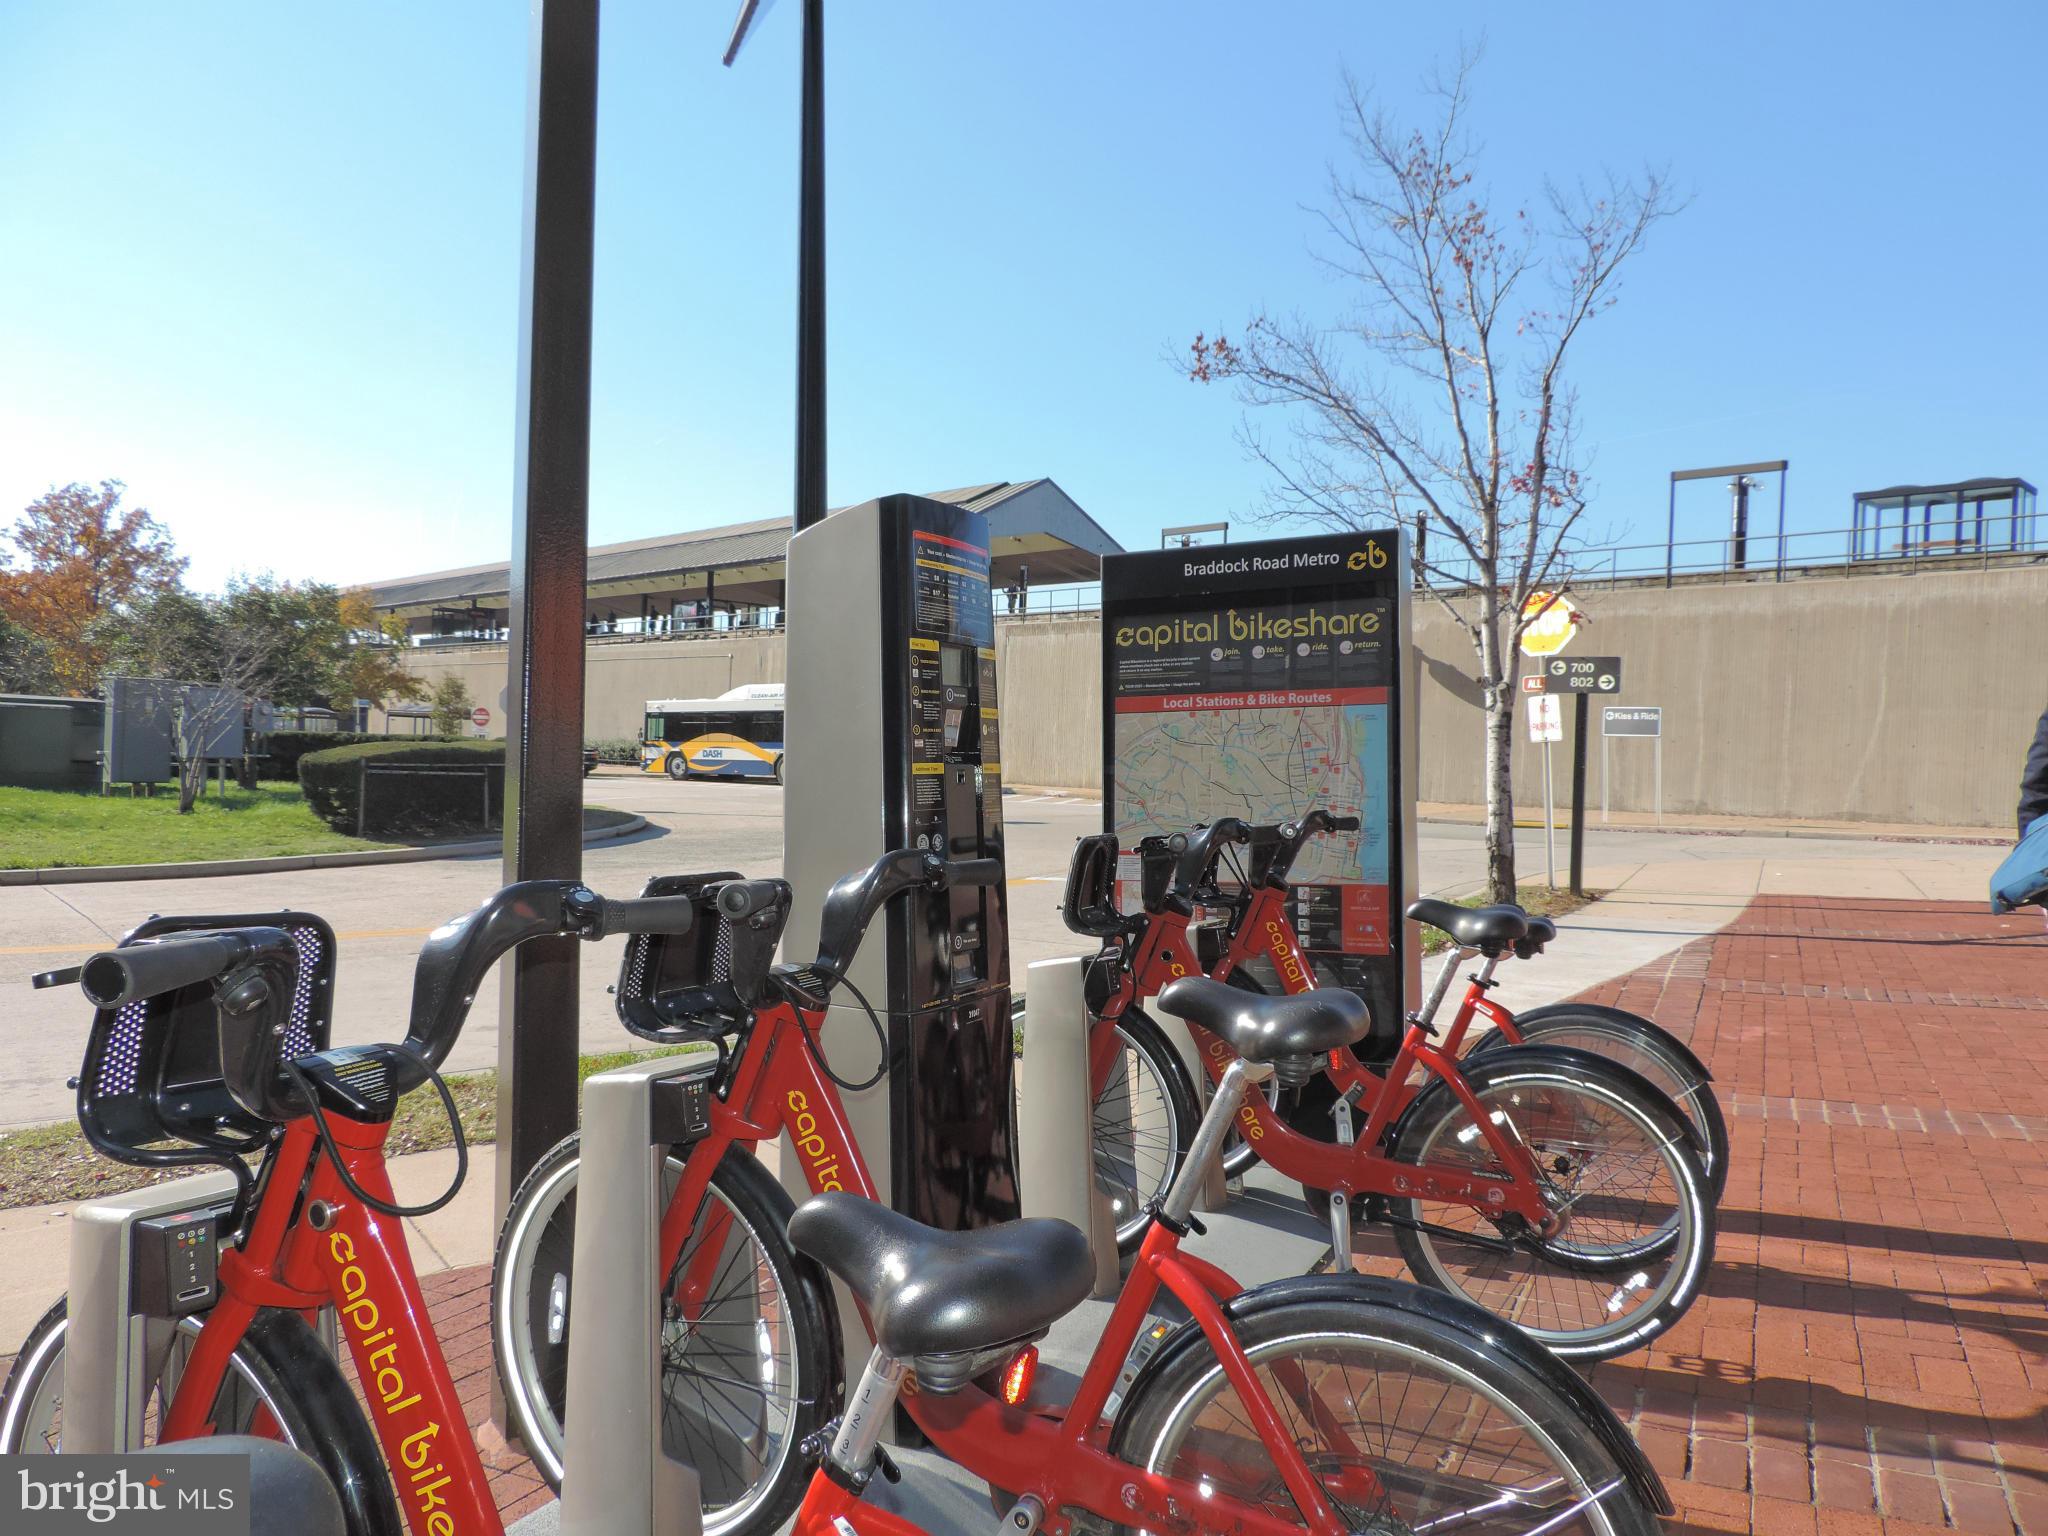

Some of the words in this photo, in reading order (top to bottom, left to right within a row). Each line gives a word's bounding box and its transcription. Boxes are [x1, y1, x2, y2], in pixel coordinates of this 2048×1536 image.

[1184, 555, 1249, 577] Braddock
[1253, 554, 1289, 571] Road
[1294, 552, 1340, 568] Metro
[1116, 614, 1218, 652] capital
[1226, 608, 1380, 641] bikeshare
[1570, 663, 1594, 673] 700
[1527, 678, 1542, 688] ALL
[1570, 678, 1594, 688] 802
[1163, 696, 1193, 709] Local
[1196, 693, 1244, 708] Stations
[1247, 693, 1256, 706] &
[1259, 692, 1286, 706] Bike
[1289, 692, 1332, 705] Routes
[1615, 712, 1631, 720] Kiss
[1641, 712, 1658, 720] Ride
[702, 749, 723, 758] DASH
[787, 1090, 843, 1192] capit
[328, 1232, 422, 1415] capital
